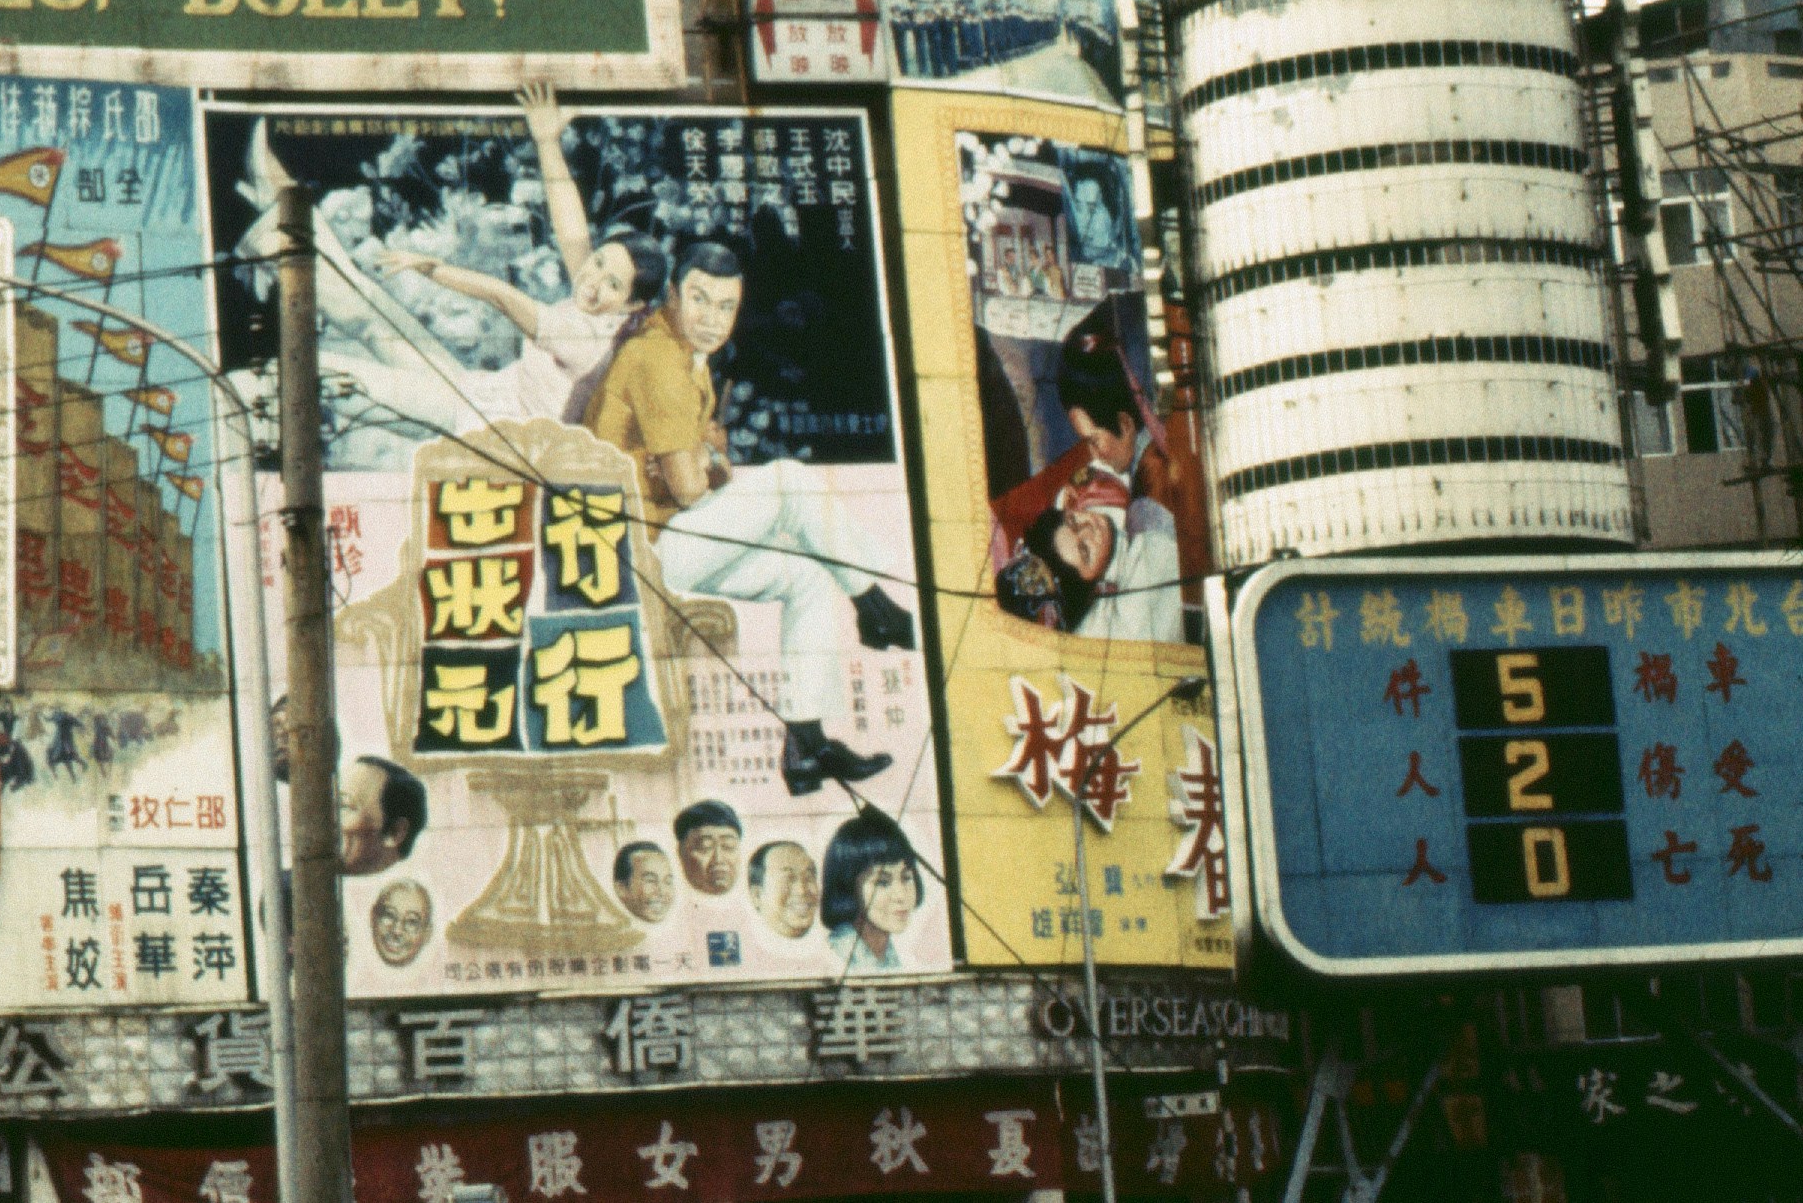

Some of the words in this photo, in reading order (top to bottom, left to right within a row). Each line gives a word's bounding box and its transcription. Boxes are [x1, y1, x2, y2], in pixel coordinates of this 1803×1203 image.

[423, 476, 525, 744] 出狀元
[535, 488, 641, 746] 行行
[1383, 658, 1432, 718] 件
[1497, 653, 1546, 723] 5
[1633, 642, 1747, 704] 車禍
[1397, 751, 1439, 798] 人
[1505, 740, 1553, 810] 2
[1637, 740, 1759, 800] 受傷
[1402, 838, 1448, 886] 人
[1522, 827, 1570, 897] 0
[131, 865, 177, 978] 岳華
